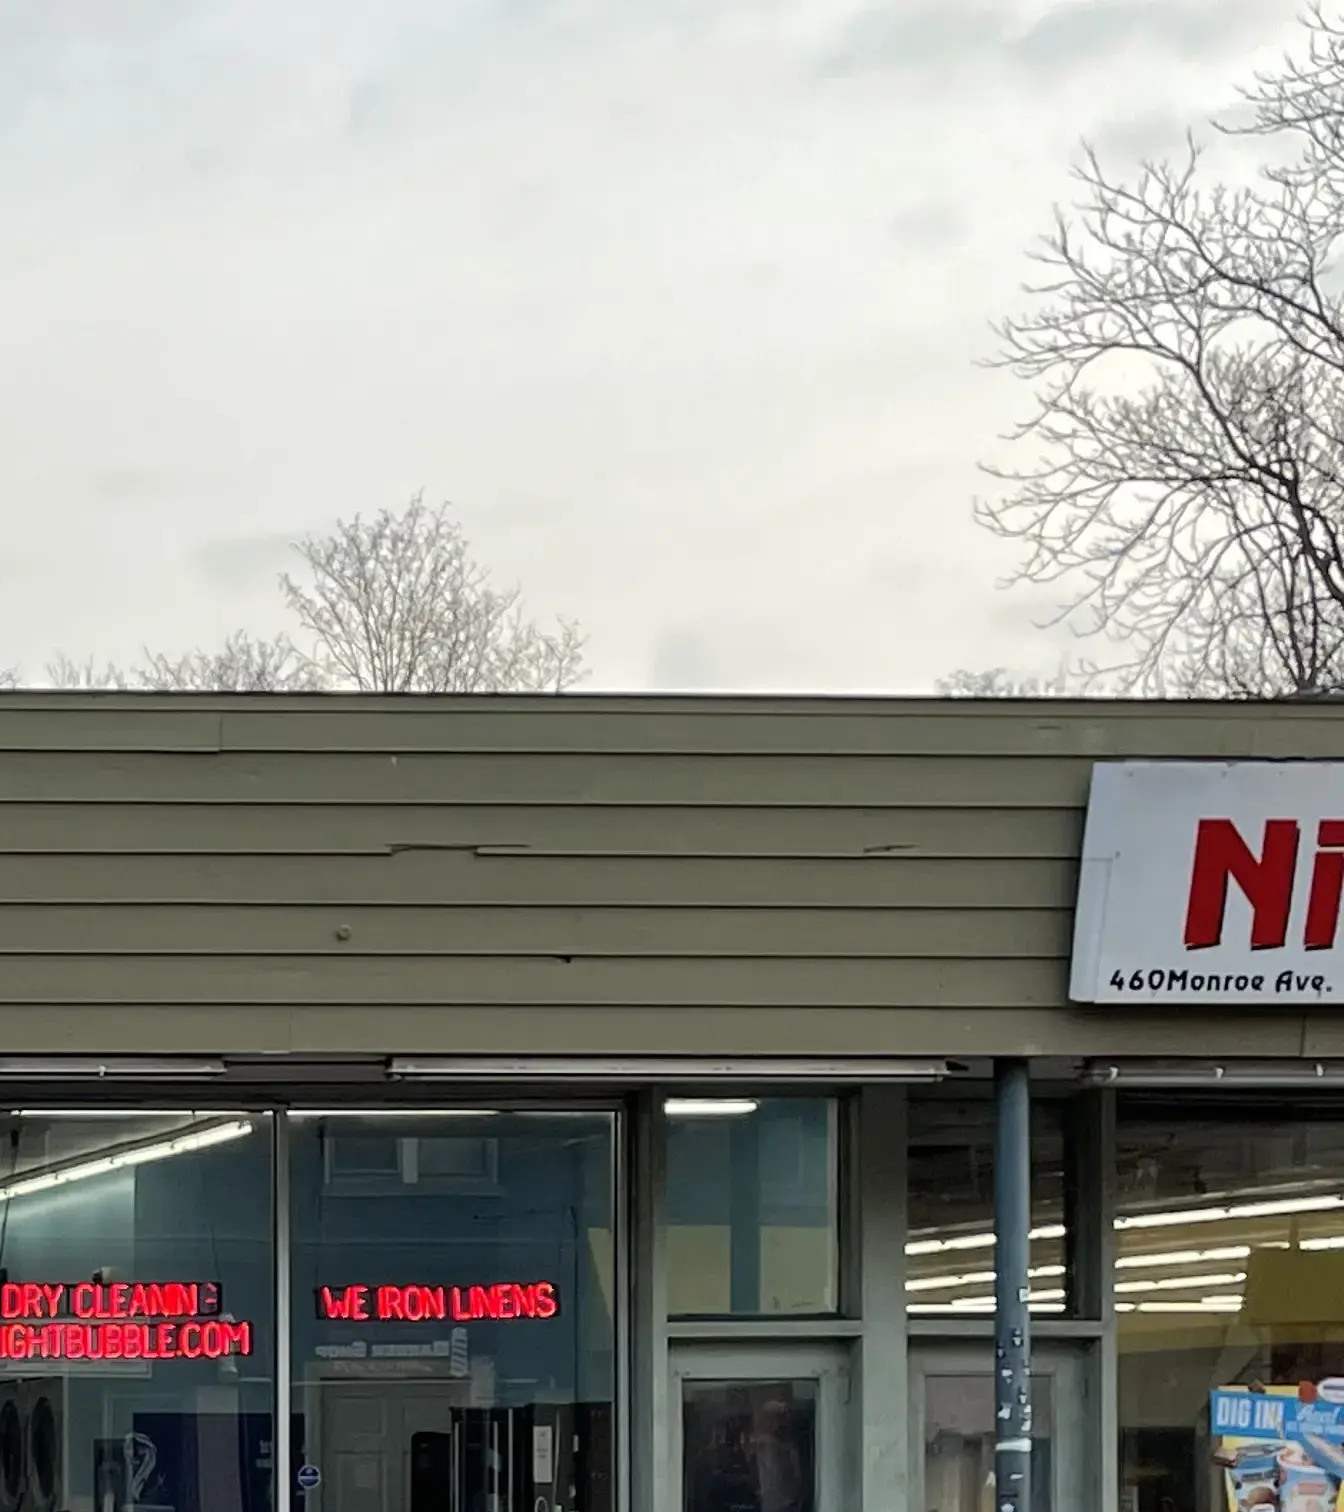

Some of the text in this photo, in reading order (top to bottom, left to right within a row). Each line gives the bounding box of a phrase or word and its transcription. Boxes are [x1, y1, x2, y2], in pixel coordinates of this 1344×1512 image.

[1275, 970, 1333, 993] Ave.
[1, 1282, 63, 1318] DRY
[321, 1280, 558, 1320] WE IRON LINENS
[1216, 1396, 1252, 1427] DIG
